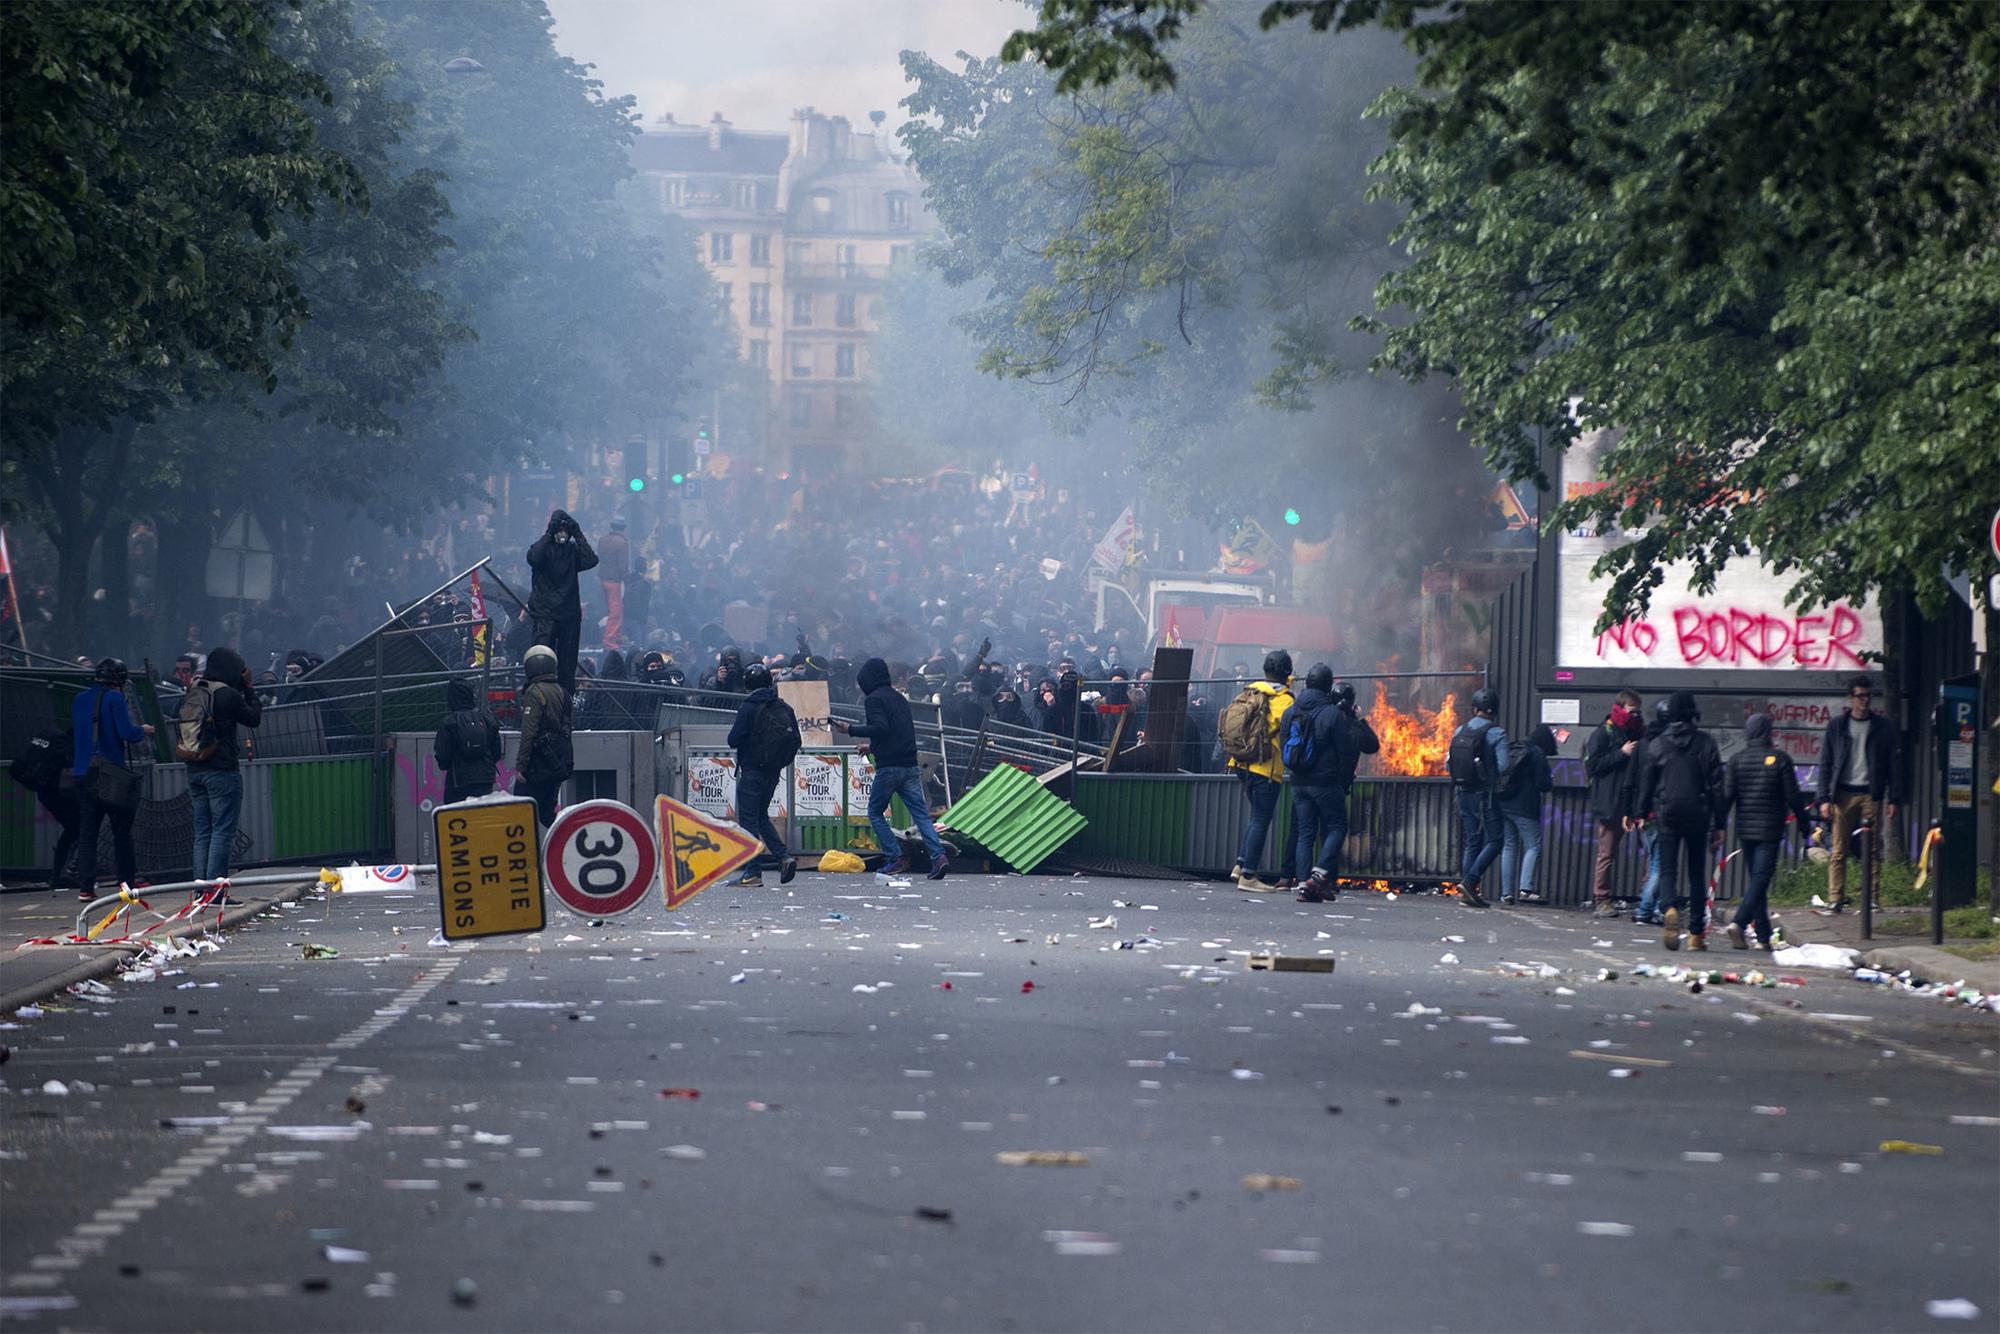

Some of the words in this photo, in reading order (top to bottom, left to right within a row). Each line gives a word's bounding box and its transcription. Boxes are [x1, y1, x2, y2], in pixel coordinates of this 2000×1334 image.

[1597, 611, 1656, 656] NO
[1673, 606, 1870, 668] BORDER
[1957, 703, 1971, 722] P
[699, 768, 724, 778] GRAND
[806, 766, 830, 777] GRAND
[699, 785, 723, 798] TOUR
[806, 783, 830, 795] TOUR
[480, 855, 499, 885] DE
[506, 825, 530, 910] SORTIE
[575, 827, 626, 894] 30
[448, 818, 475, 929] CAMIONS
